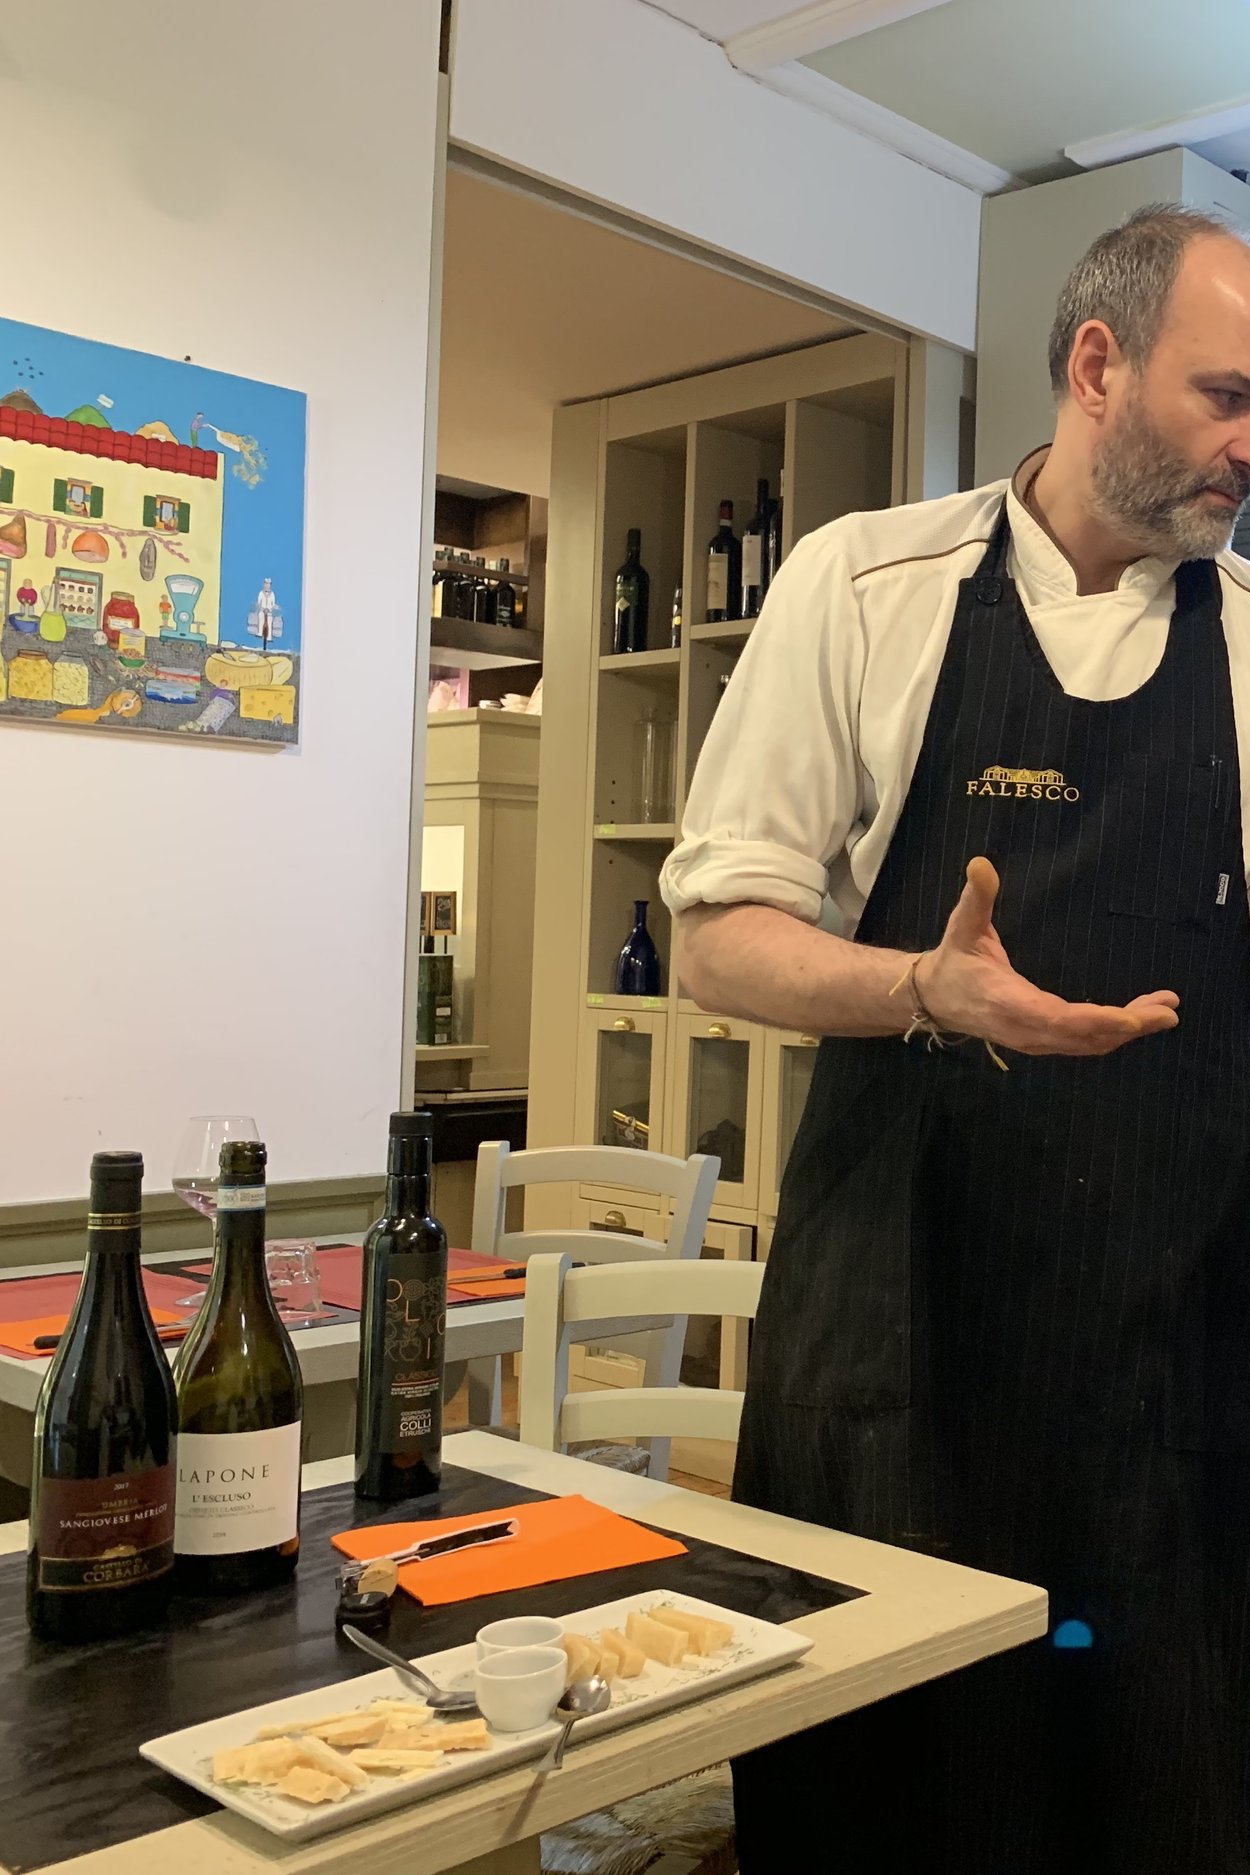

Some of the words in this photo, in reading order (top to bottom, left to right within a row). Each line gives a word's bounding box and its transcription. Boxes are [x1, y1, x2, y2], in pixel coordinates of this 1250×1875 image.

[966, 780, 1080, 802] FALESCO
[399, 1418, 432, 1431] COLLI
[179, 1464, 270, 1484] LAPONE
[59, 1514, 131, 1529] SANGIOVESE
[134, 1503, 168, 1520] MERLOT
[83, 1563, 149, 1583] CORBARA
